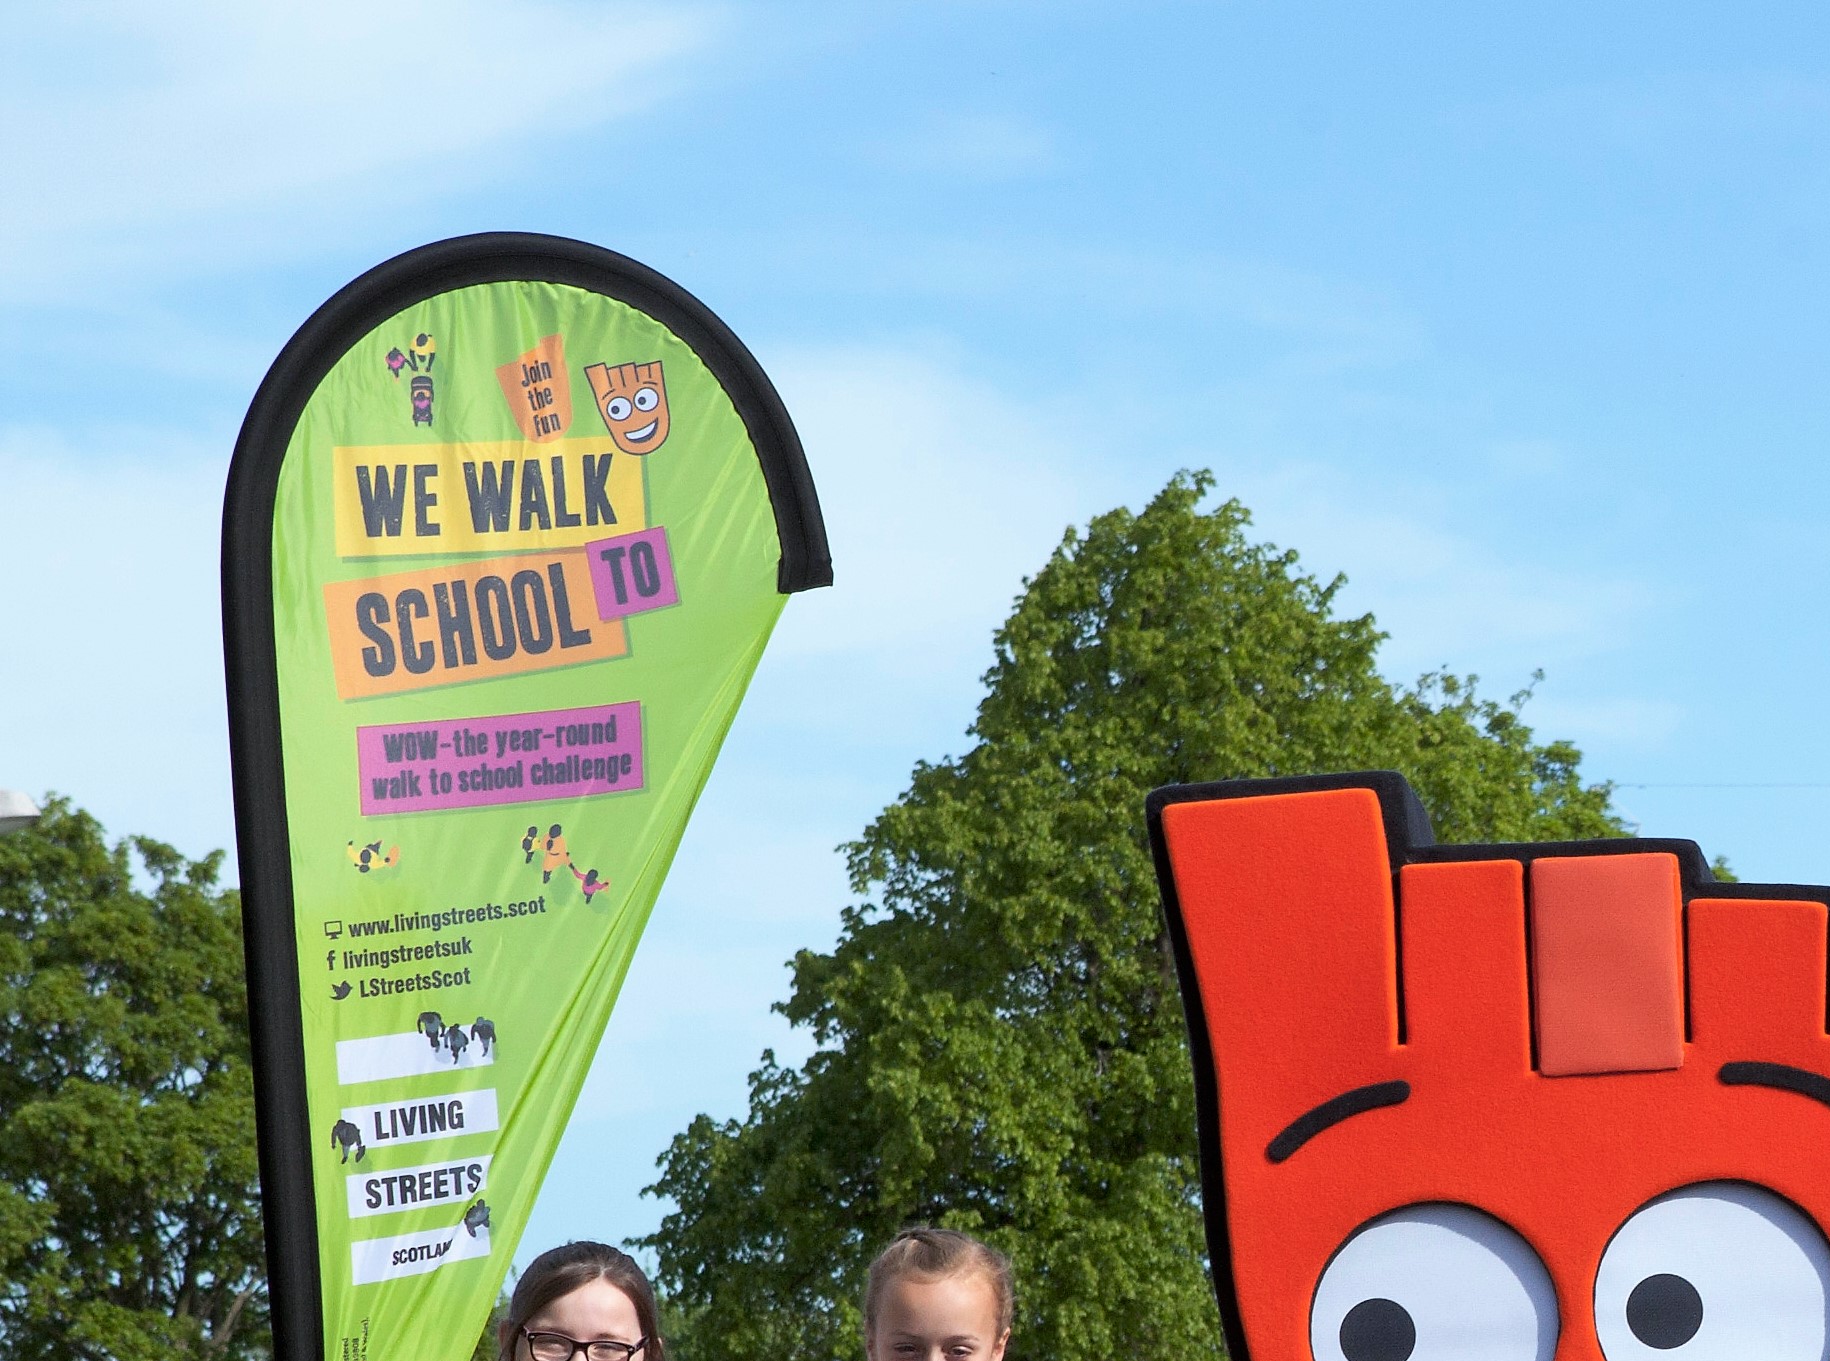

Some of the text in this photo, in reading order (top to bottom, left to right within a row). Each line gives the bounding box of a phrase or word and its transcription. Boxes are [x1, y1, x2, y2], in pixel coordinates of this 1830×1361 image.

[522, 360, 552, 387] Join
[528, 387, 553, 411] the
[356, 453, 617, 537] WE WALK
[356, 541, 661, 677] SCHOOL TO
[495, 714, 617, 758] year-round
[372, 753, 632, 800] walk to school challenge
[348, 896, 546, 937] www.livingstreets.scot
[344, 937, 472, 969] livingstreetsuk
[360, 968, 470, 997] LStreetsScot
[375, 1101, 464, 1140] LIVING
[366, 1164, 482, 1208] STREETS
